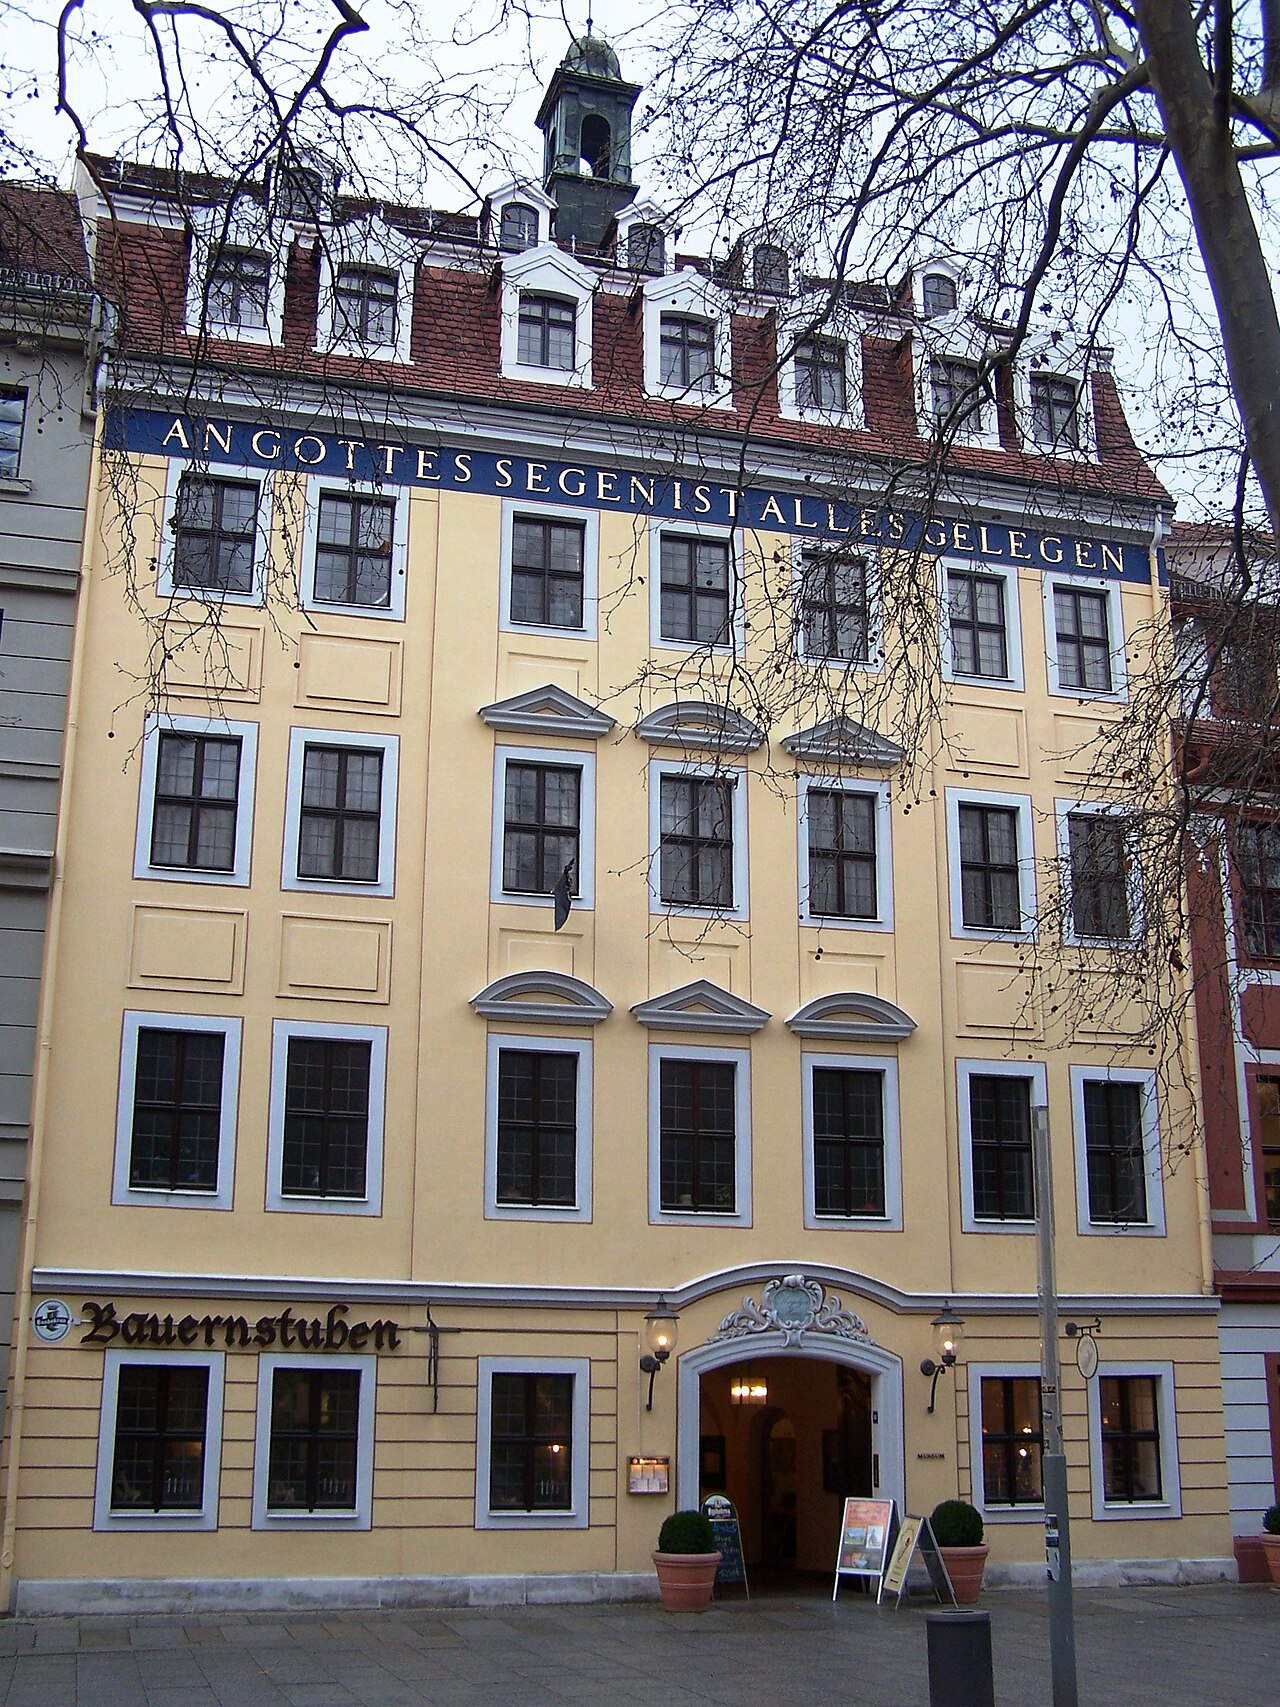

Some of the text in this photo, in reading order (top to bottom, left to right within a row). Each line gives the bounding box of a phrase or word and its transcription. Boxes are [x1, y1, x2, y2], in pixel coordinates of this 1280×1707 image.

[161, 417, 1125, 574] AN GOTTES SEGEN IST ALLES GELEGEN
[80, 1301, 402, 1350] Bauernstuben
